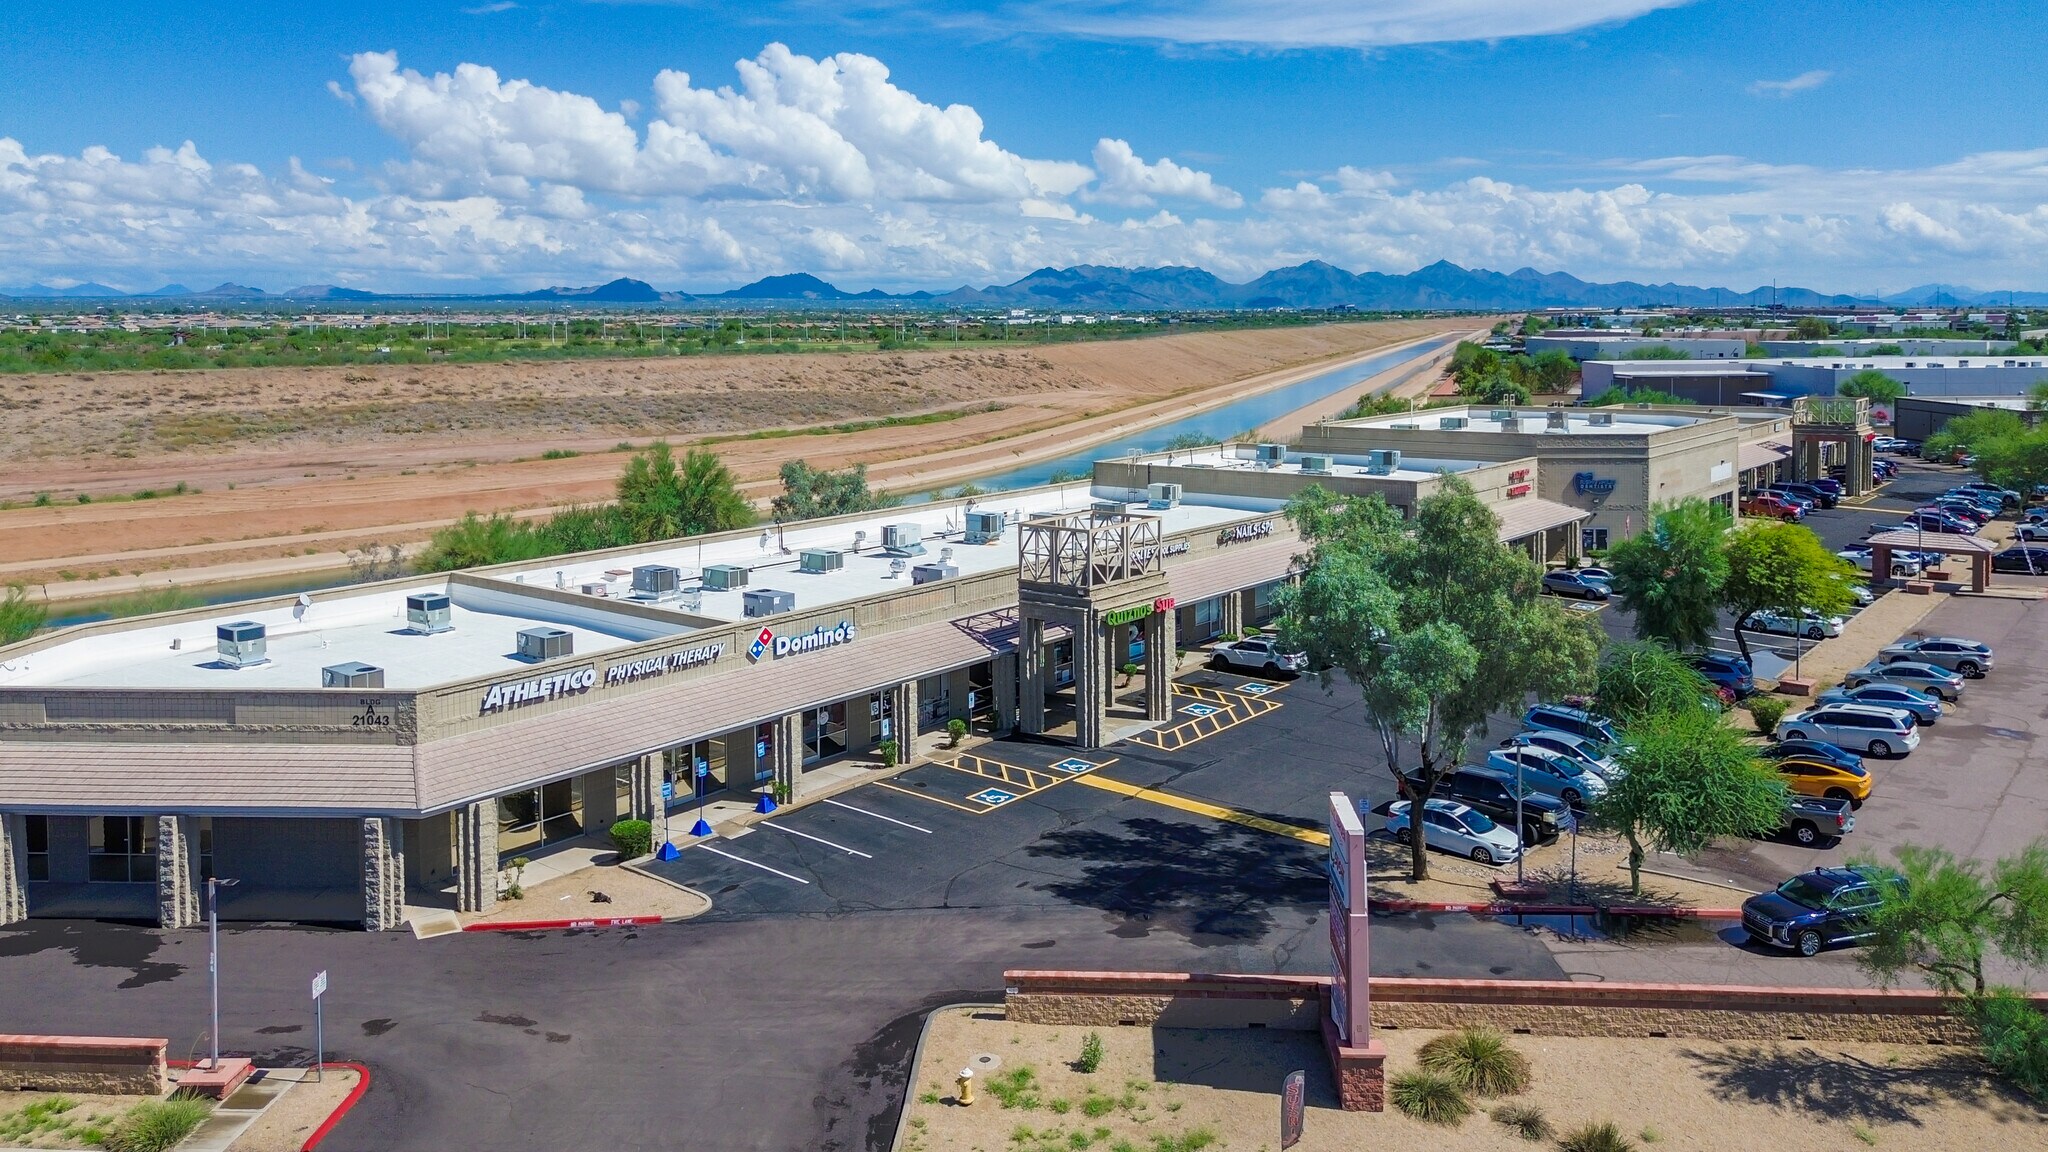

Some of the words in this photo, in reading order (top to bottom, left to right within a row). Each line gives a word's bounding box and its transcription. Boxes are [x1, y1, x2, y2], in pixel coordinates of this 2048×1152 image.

[1235, 523, 1257, 539] NAILS
[1261, 520, 1274, 533] SPA
[776, 621, 856, 656] Domino's
[483, 668, 598, 710] ATHLETICO
[606, 655, 668, 682] PHYSICAL
[671, 642, 727, 667] THERAPY
[352, 715, 390, 726] 21043
[365, 704, 376, 716] A
[1286, 1082, 1299, 1135] SUSHI
